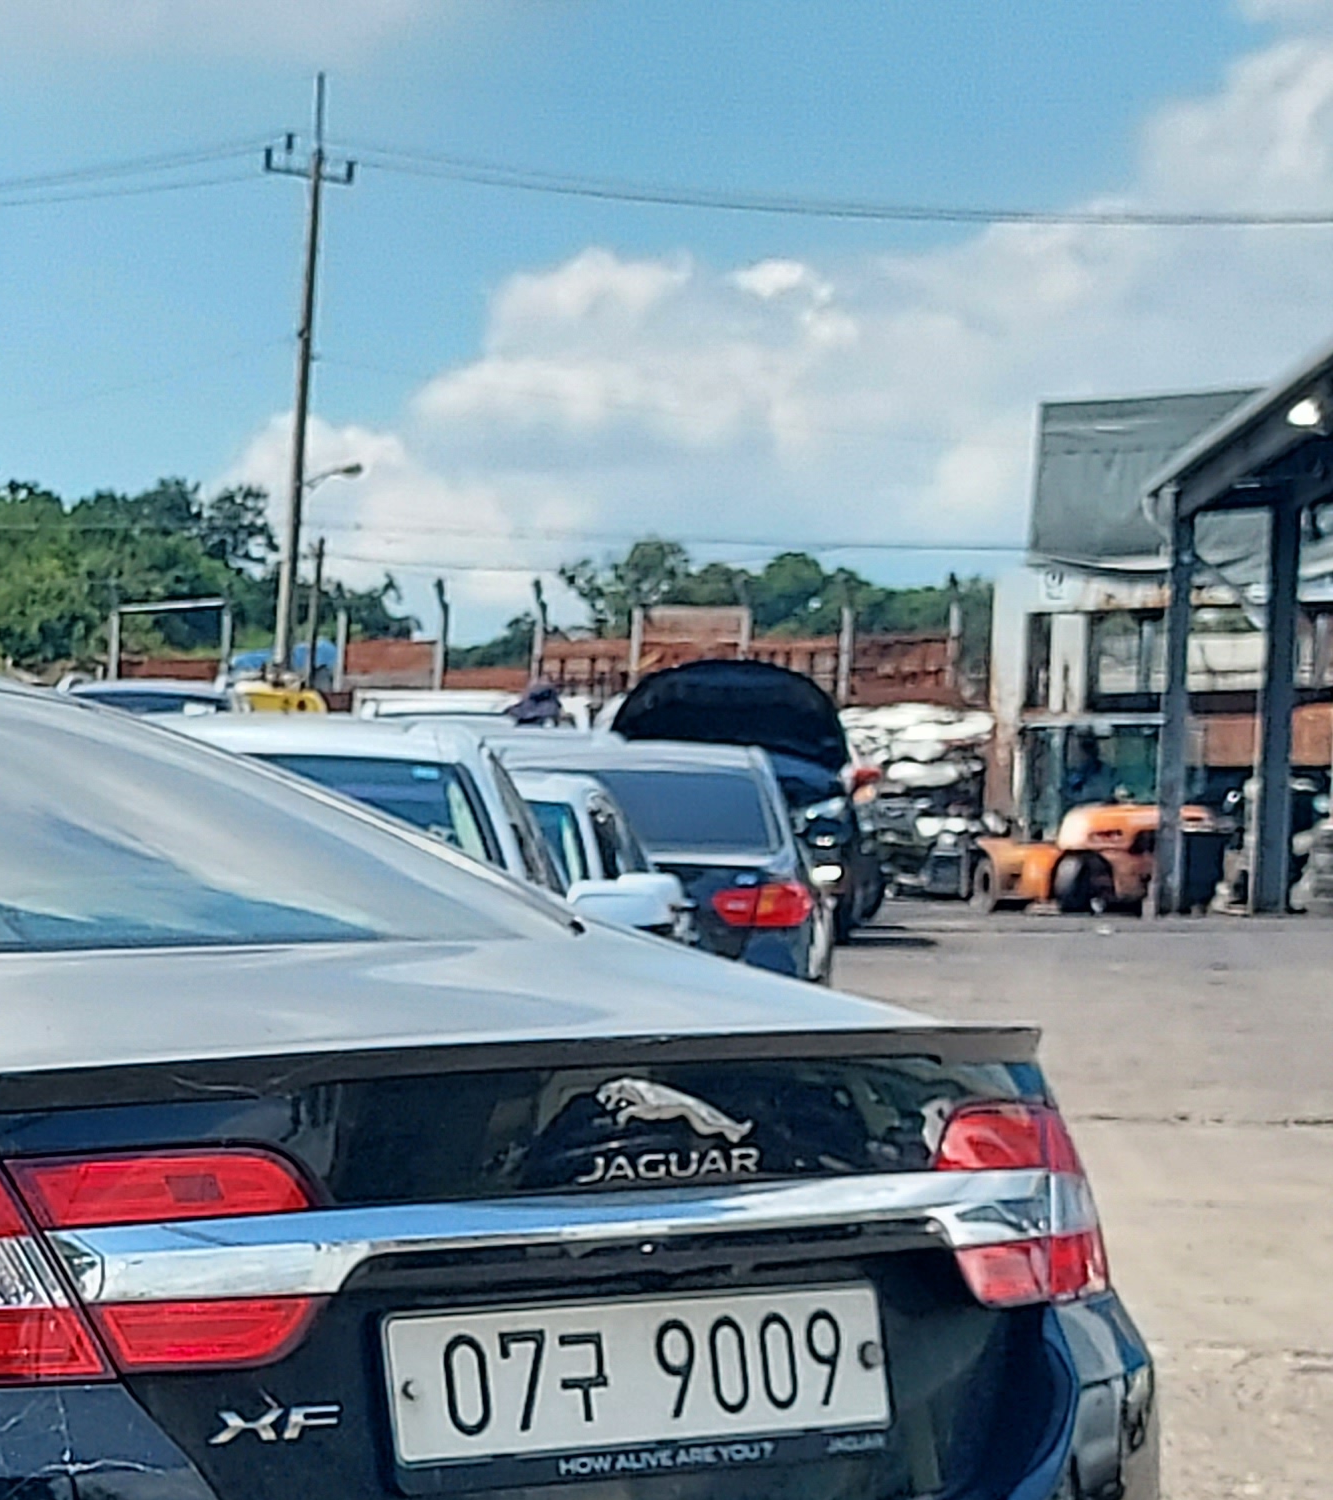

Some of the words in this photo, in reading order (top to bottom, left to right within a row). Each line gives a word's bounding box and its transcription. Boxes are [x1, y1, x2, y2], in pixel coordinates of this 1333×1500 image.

[575, 1146, 761, 1185] JAGUAR
[442, 1328, 609, 1437] 07구
[655, 1308, 842, 1420] 9009
[207, 1404, 341, 1445] XF
[557, 1454, 613, 1476] HOW
[614, 1450, 674, 1471] ALIVE
[674, 1445, 718, 1467] ARE
